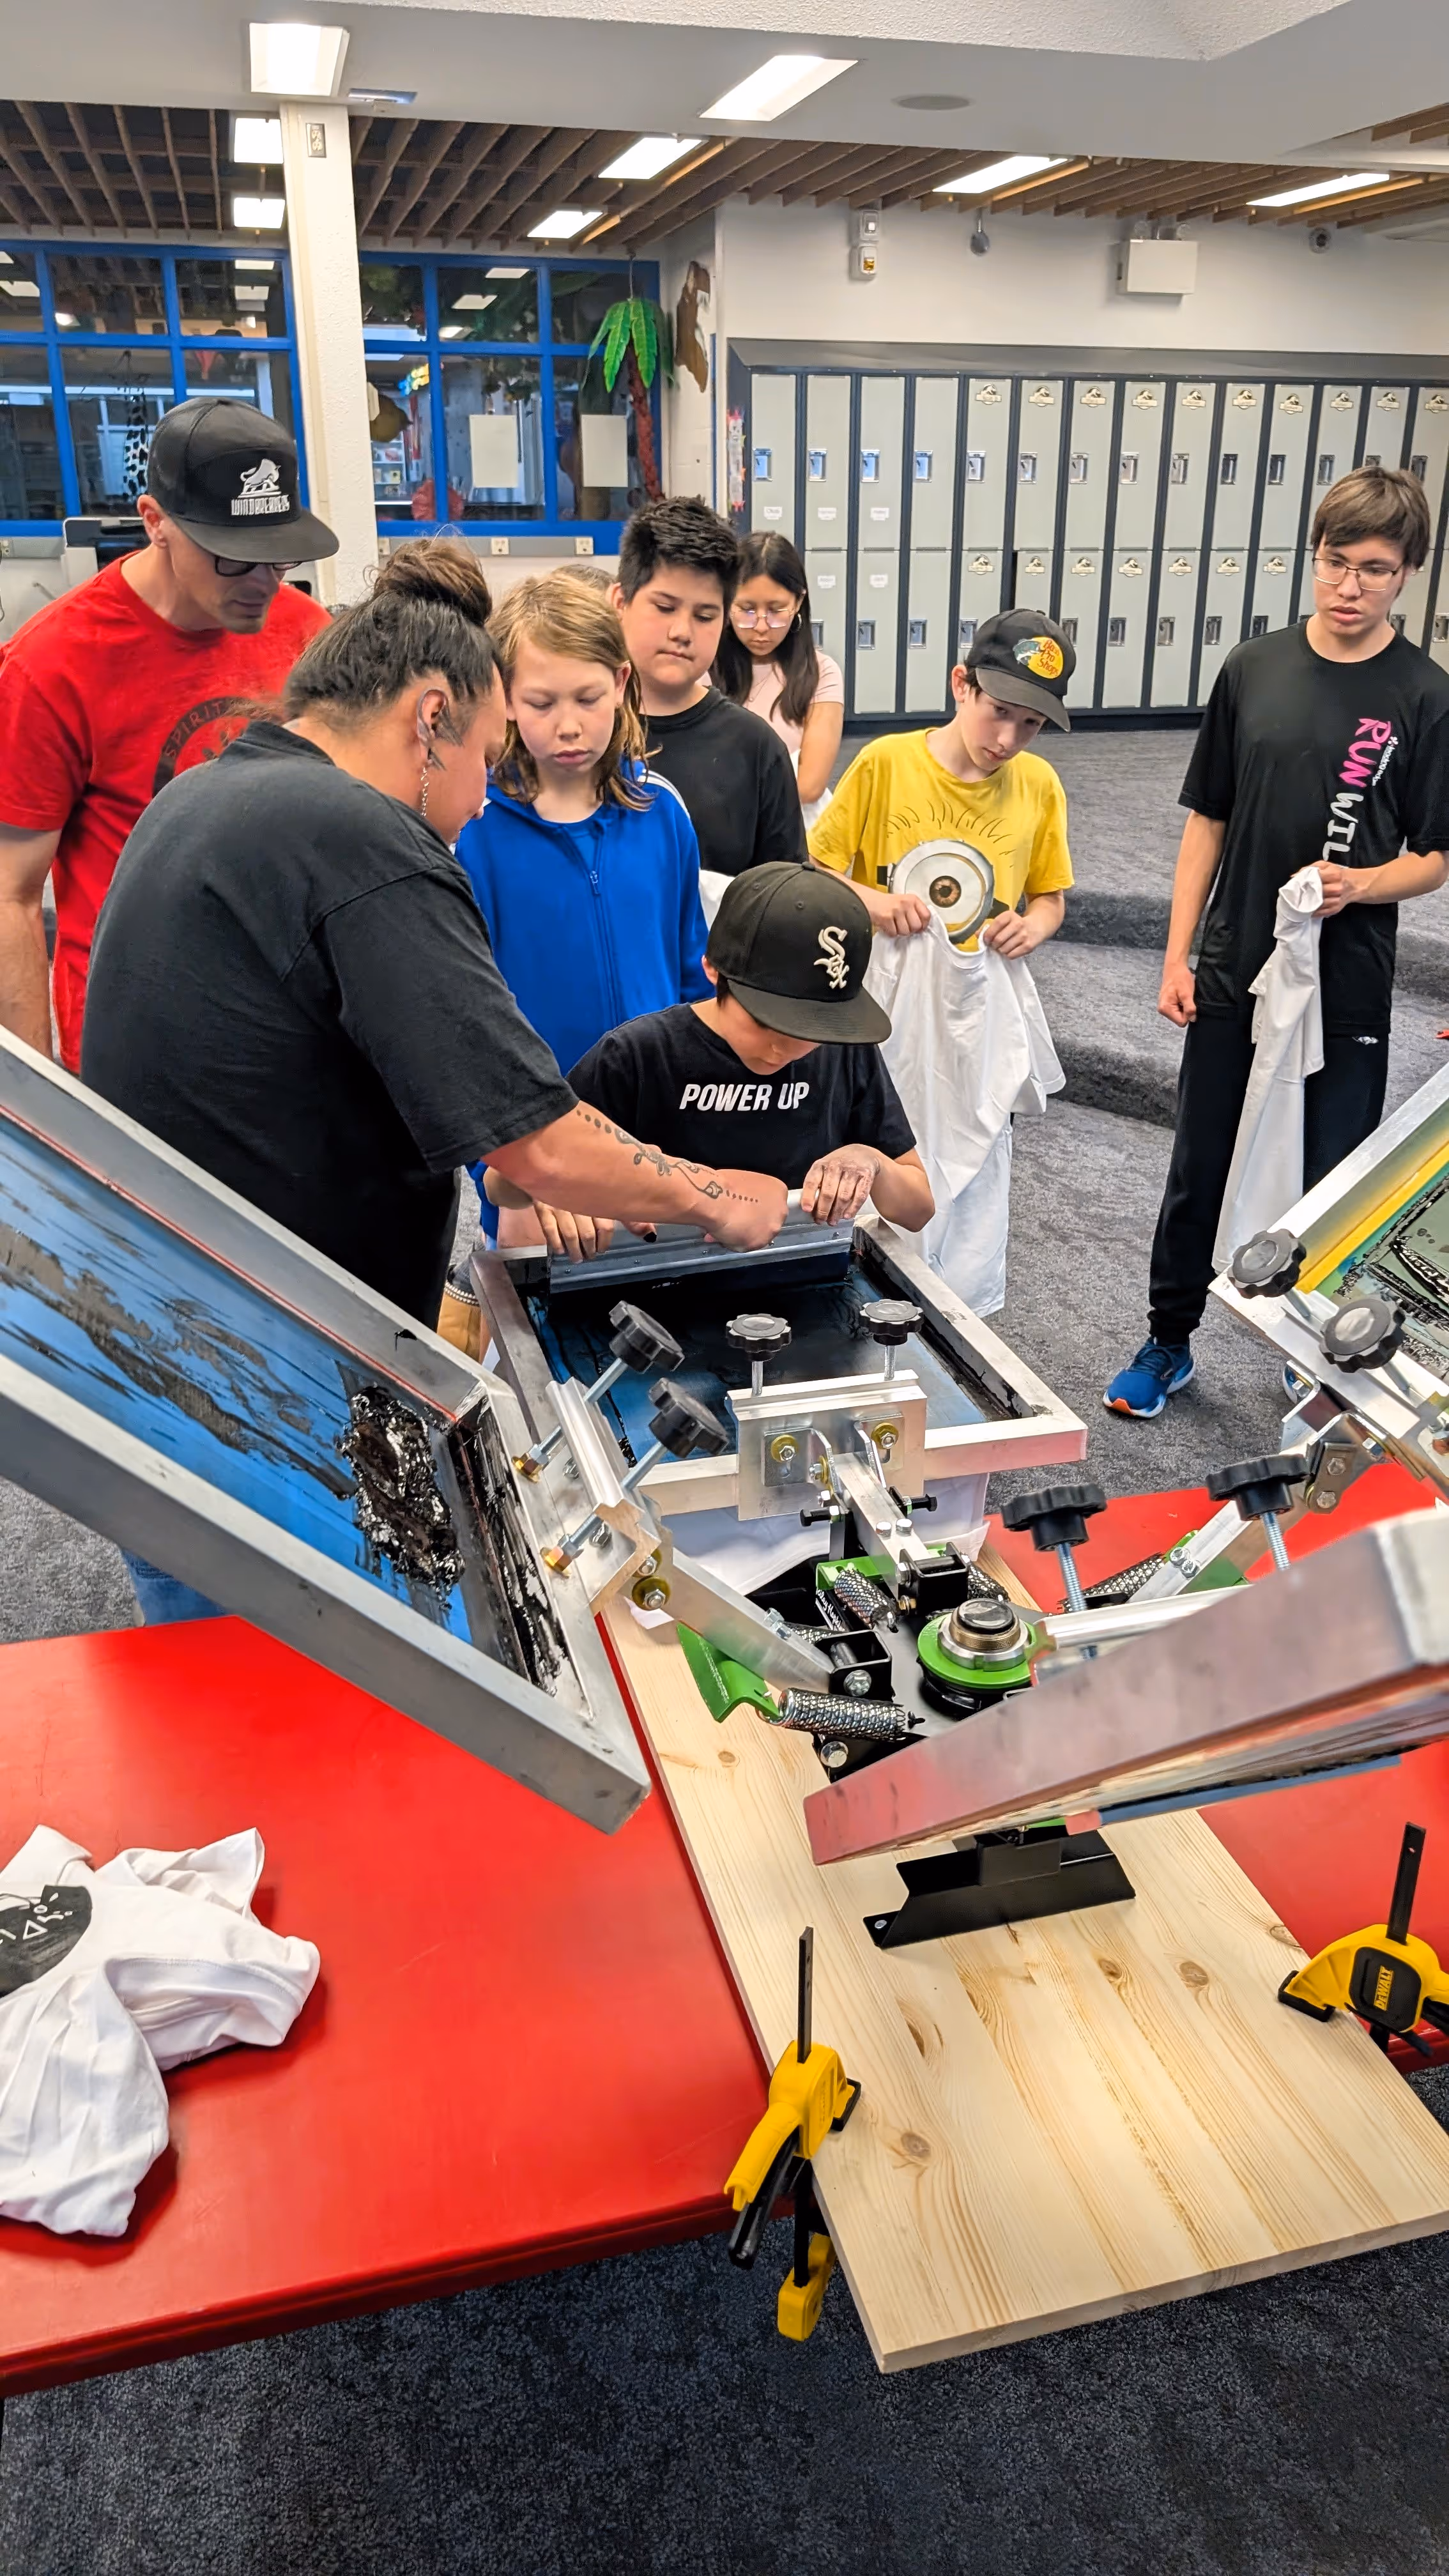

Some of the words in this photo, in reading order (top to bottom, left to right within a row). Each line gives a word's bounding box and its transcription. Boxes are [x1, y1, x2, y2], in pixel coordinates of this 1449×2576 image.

[164, 702, 223, 758] SPIRIT
[1338, 718, 1392, 788] RUN
[1322, 792, 1365, 869] WIL
[679, 1084, 773, 1112] POWER
[777, 1082, 810, 1110] UP
[1374, 1965, 1395, 2011] DEWALT
